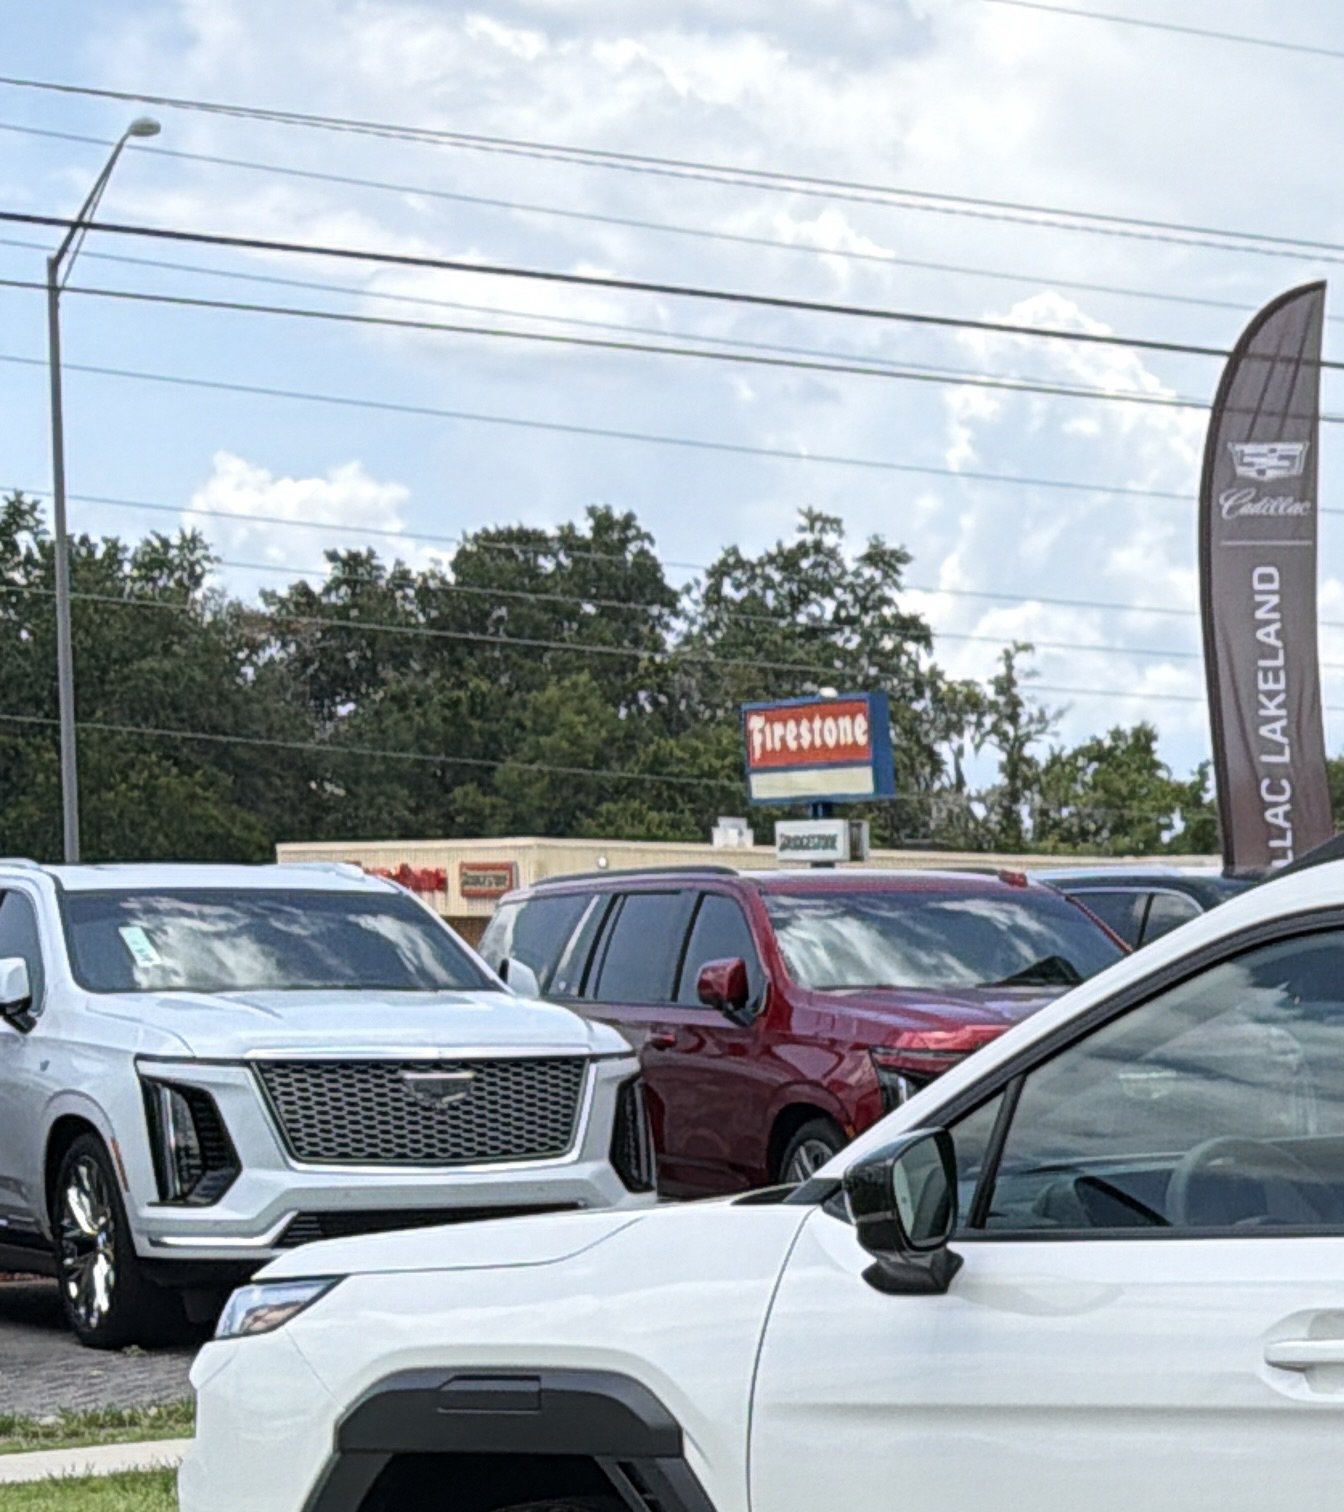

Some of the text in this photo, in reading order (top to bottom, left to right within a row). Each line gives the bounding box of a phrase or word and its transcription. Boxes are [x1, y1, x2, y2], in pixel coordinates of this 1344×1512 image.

[1218, 487, 1312, 520] Cadillac
[1251, 565, 1292, 763] LAKELAND
[747, 712, 869, 763] Firestone
